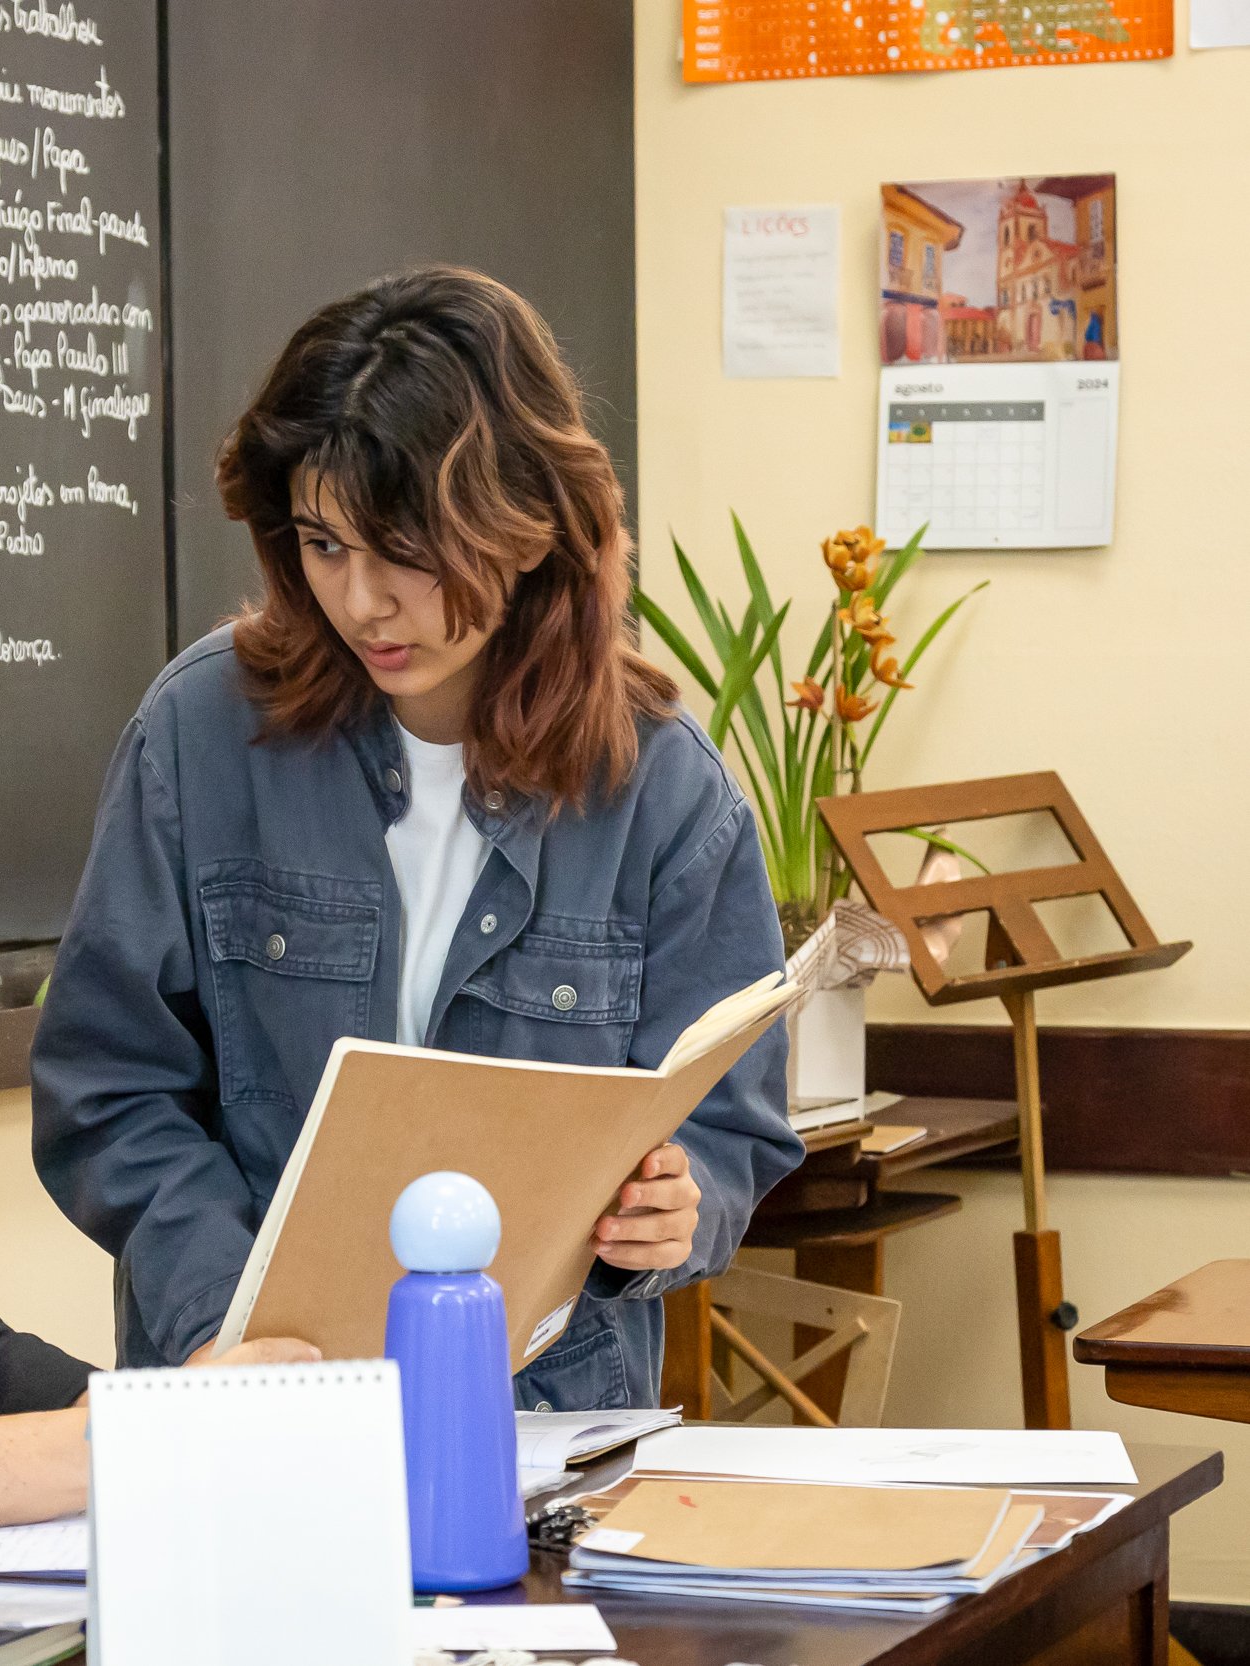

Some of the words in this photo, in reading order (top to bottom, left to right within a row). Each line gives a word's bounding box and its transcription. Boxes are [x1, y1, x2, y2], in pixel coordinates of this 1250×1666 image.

[122, 302, 154, 332] com
[14, 330, 54, 390] Papa
[57, 330, 109, 377] Paulo
[894, 382, 944, 397] agosto
[1076, 378, 1109, 390] 2024
[1, 384, 48, 419] Deus
[60, 483, 85, 504] em
